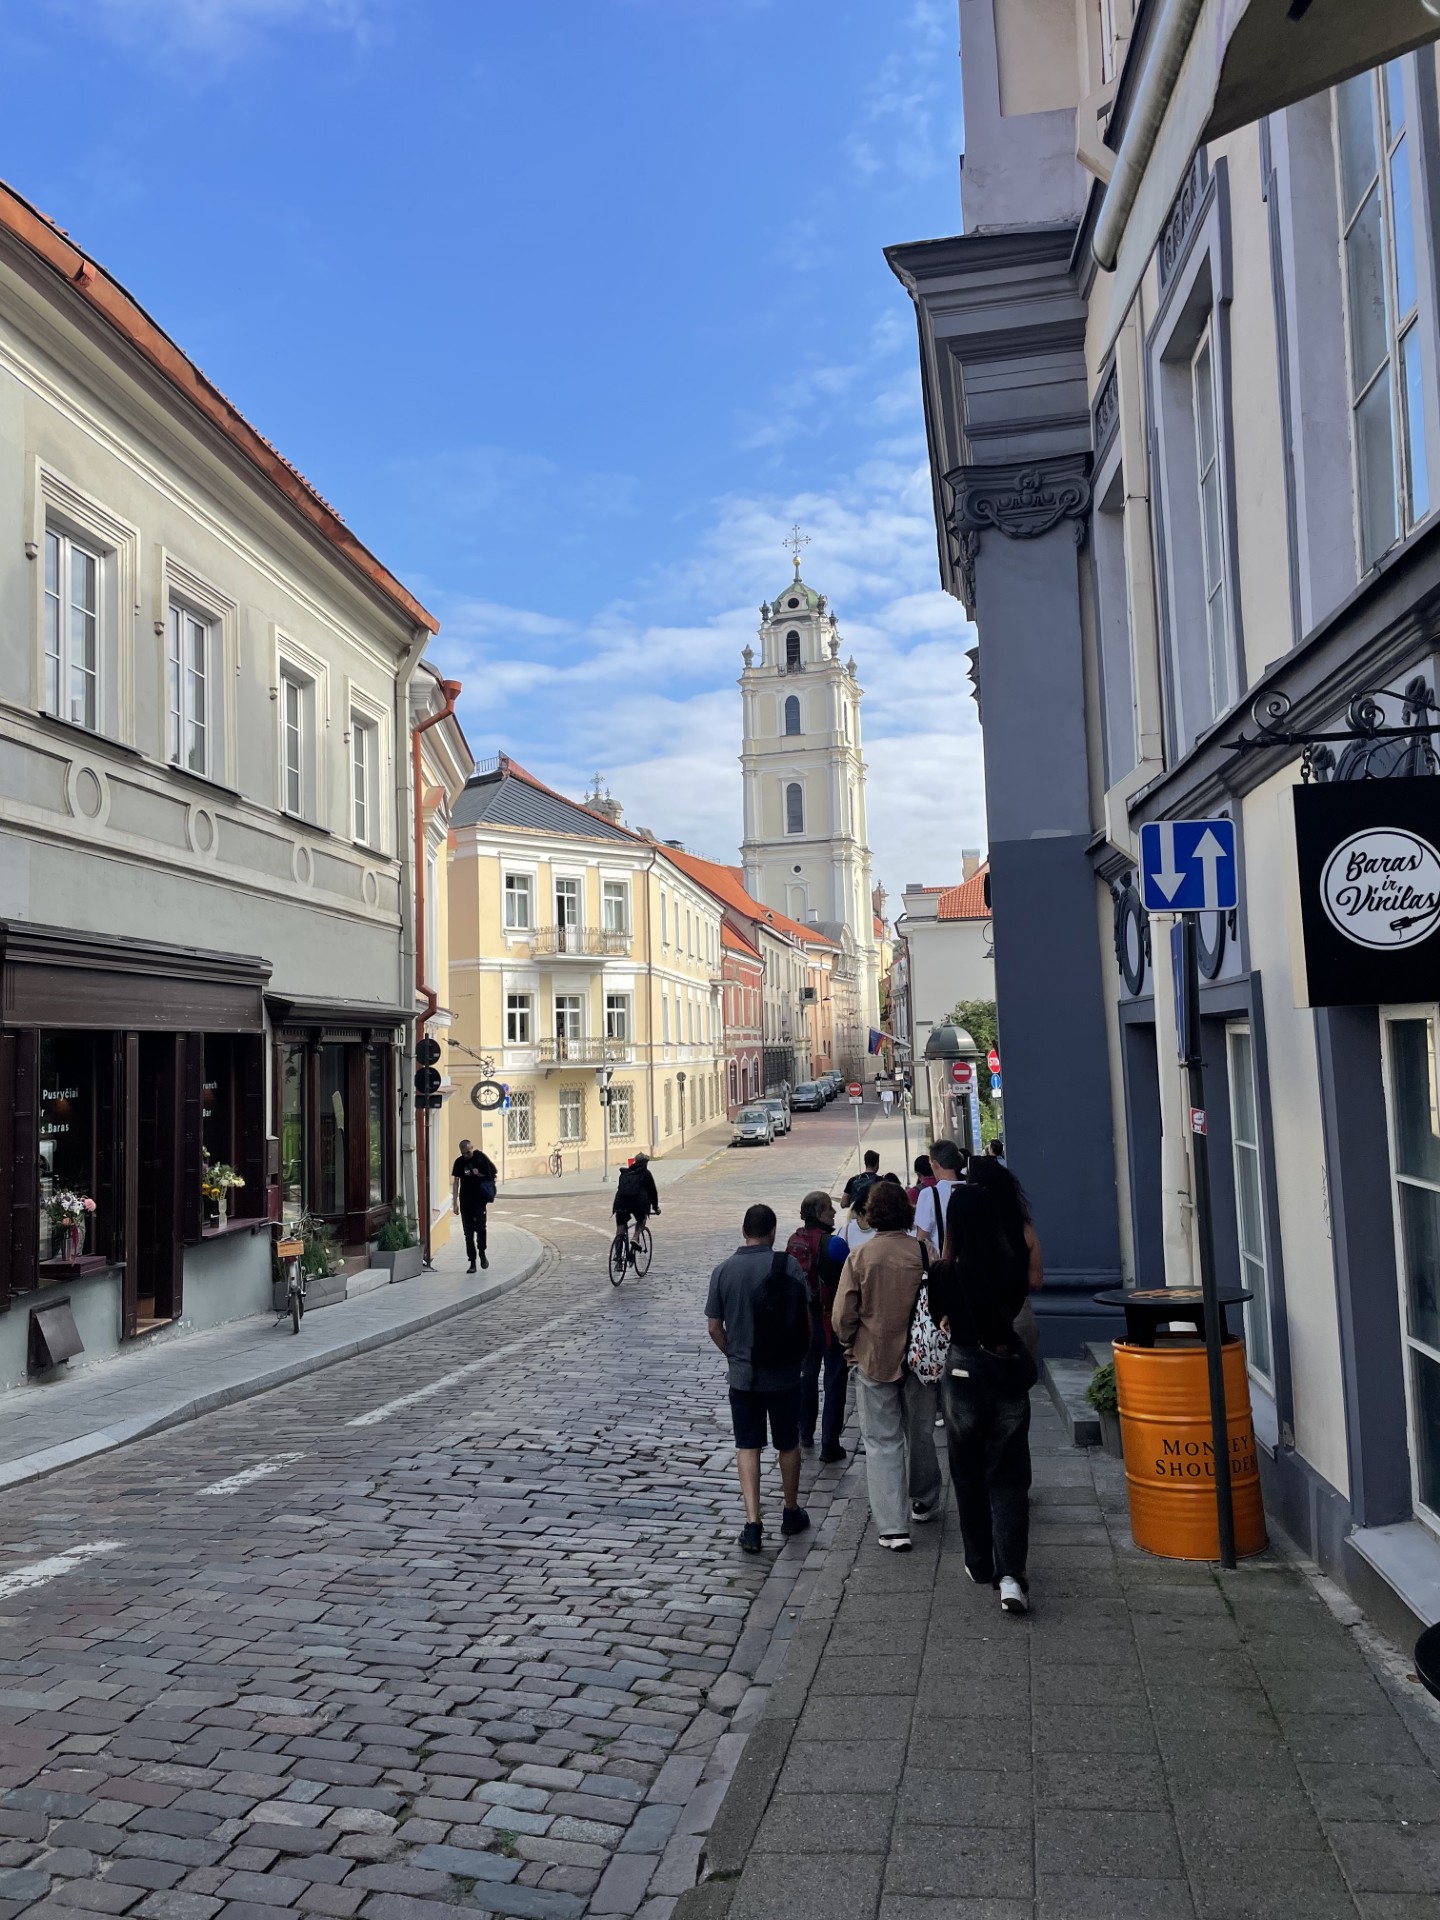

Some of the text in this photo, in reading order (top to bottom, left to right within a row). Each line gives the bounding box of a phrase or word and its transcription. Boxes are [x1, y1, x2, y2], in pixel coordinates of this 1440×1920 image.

[1346, 850, 1417, 882] Baras
[1381, 874, 1398, 891] ir
[1335, 884, 1436, 917] Vinilas
[42, 1087, 79, 1102] Pusryčiai
[202, 1081, 218, 1090] runch
[47, 1123, 70, 1133] Baras
[1162, 1435, 1249, 1457] MONEY
[1155, 1454, 1257, 1478] SHOUDER
